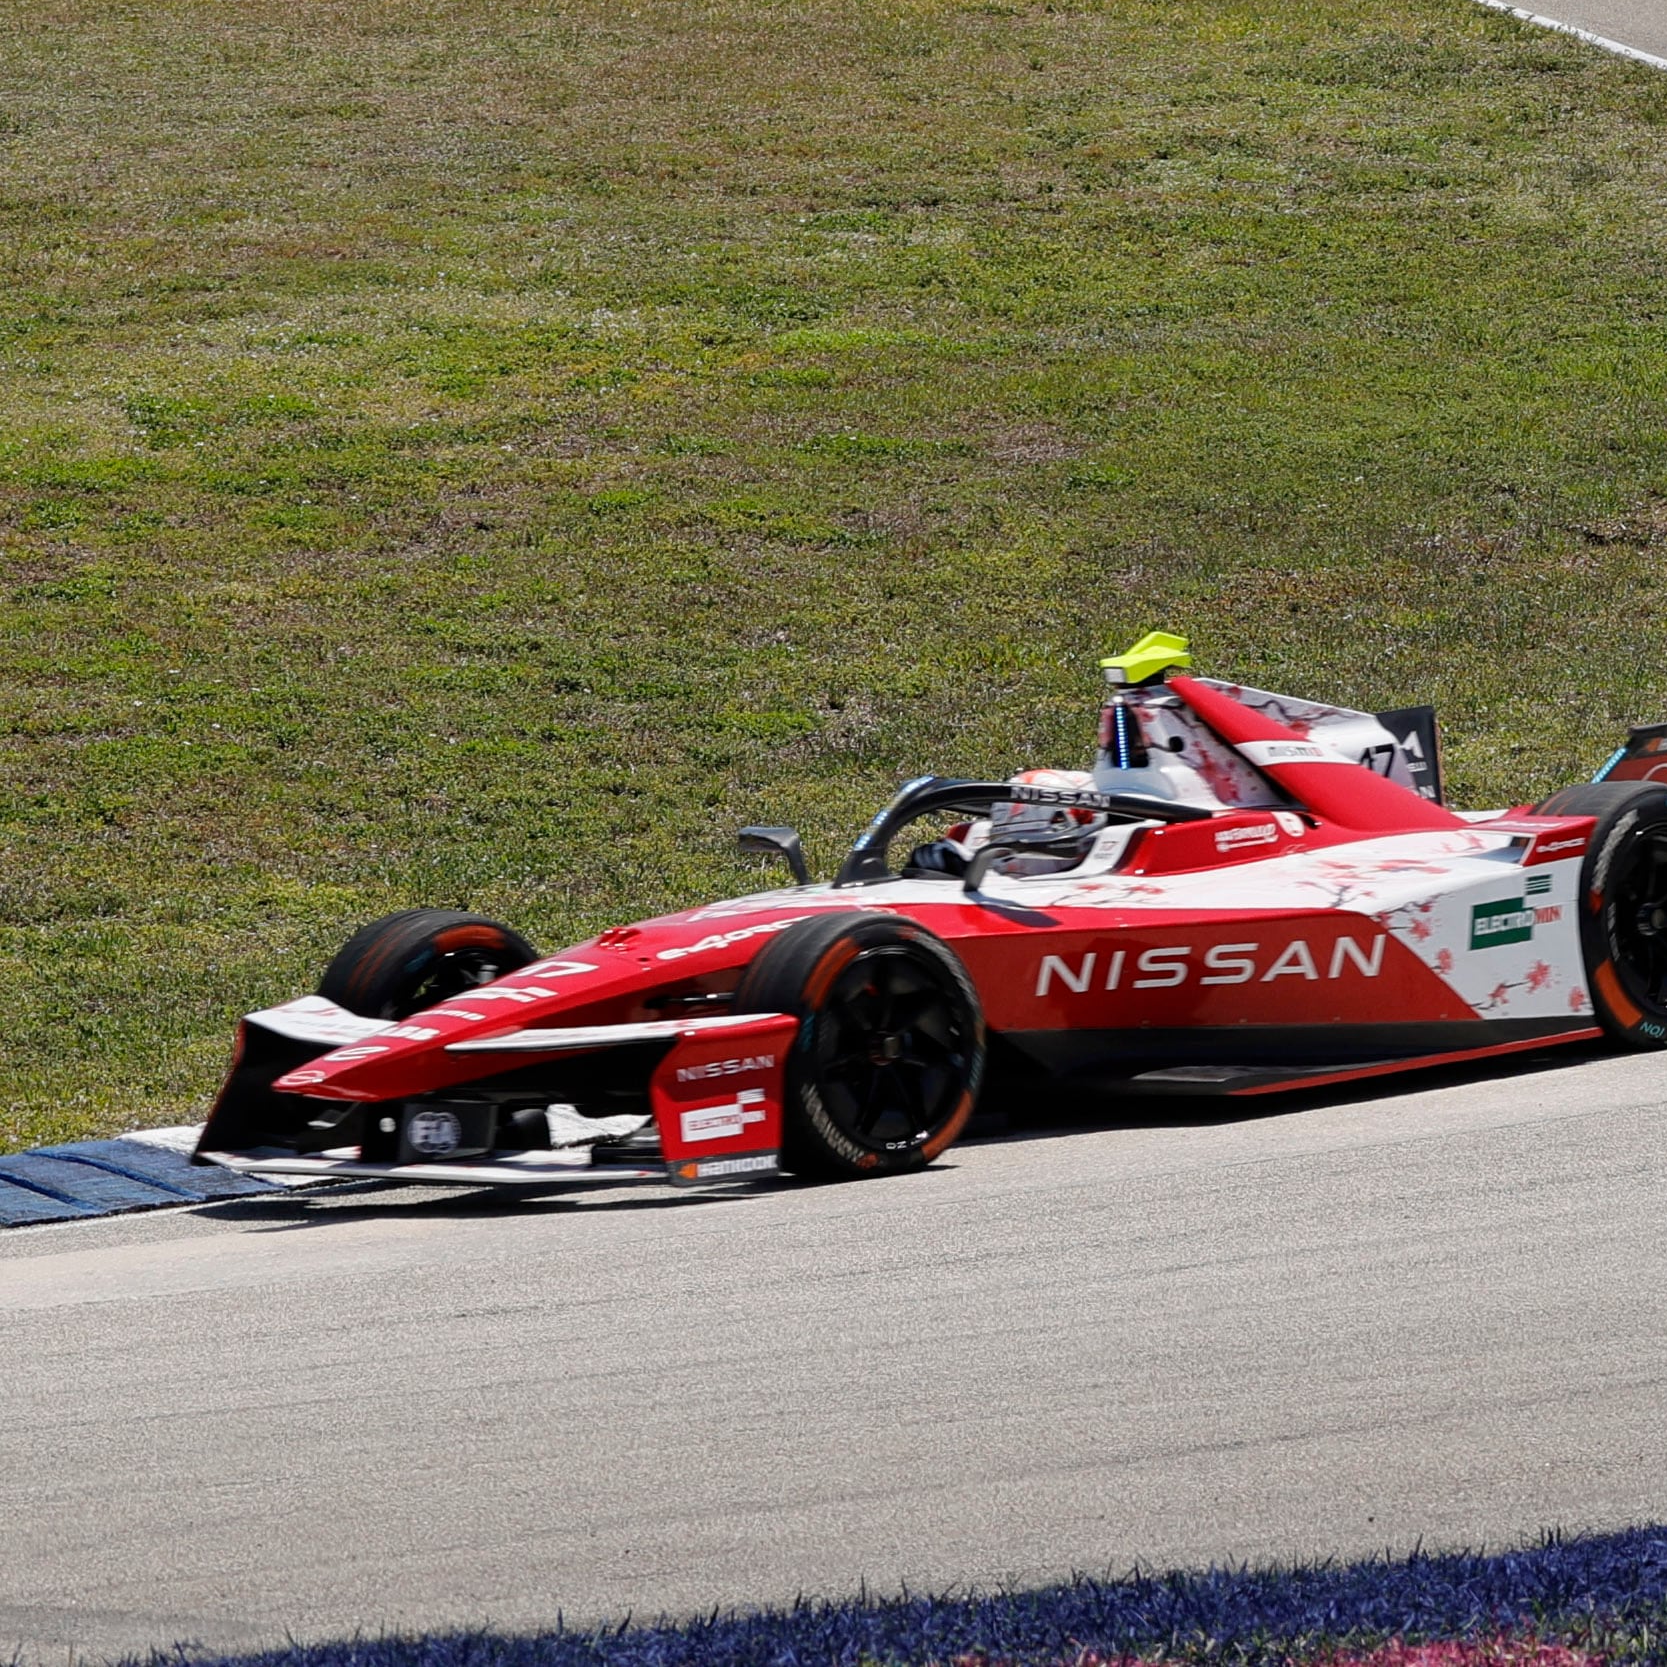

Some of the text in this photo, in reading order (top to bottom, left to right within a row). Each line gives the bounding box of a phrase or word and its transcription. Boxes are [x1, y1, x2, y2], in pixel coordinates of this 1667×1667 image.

[1009, 786, 1112, 809] NISSAN
[1033, 933, 1389, 998] NISSAN
[676, 1054, 776, 1082] NISSAN
